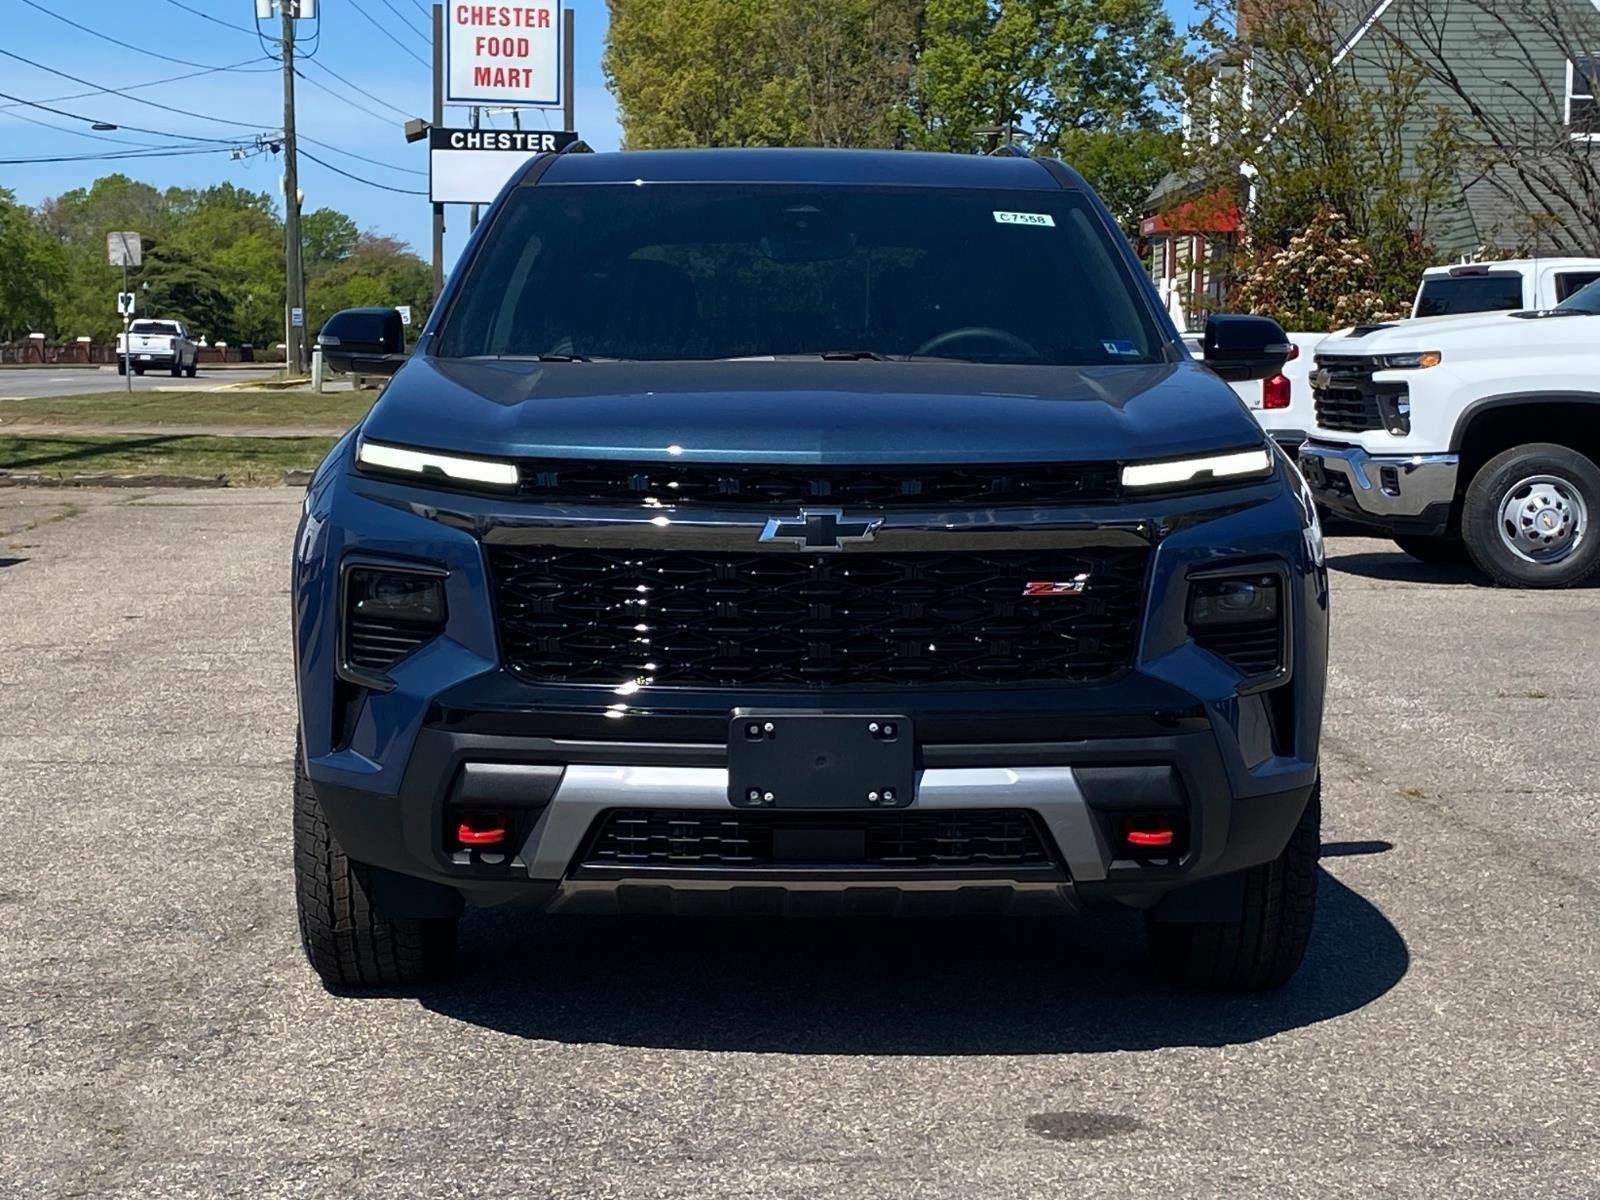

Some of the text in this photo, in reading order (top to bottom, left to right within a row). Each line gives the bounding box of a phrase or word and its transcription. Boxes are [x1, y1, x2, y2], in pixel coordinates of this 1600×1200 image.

[456, 5, 550, 28] CHESTER
[475, 36, 529, 58] FOOD
[474, 66, 533, 88] MART
[450, 132, 556, 150] CHESTER
[1000, 213, 1046, 224] C7558
